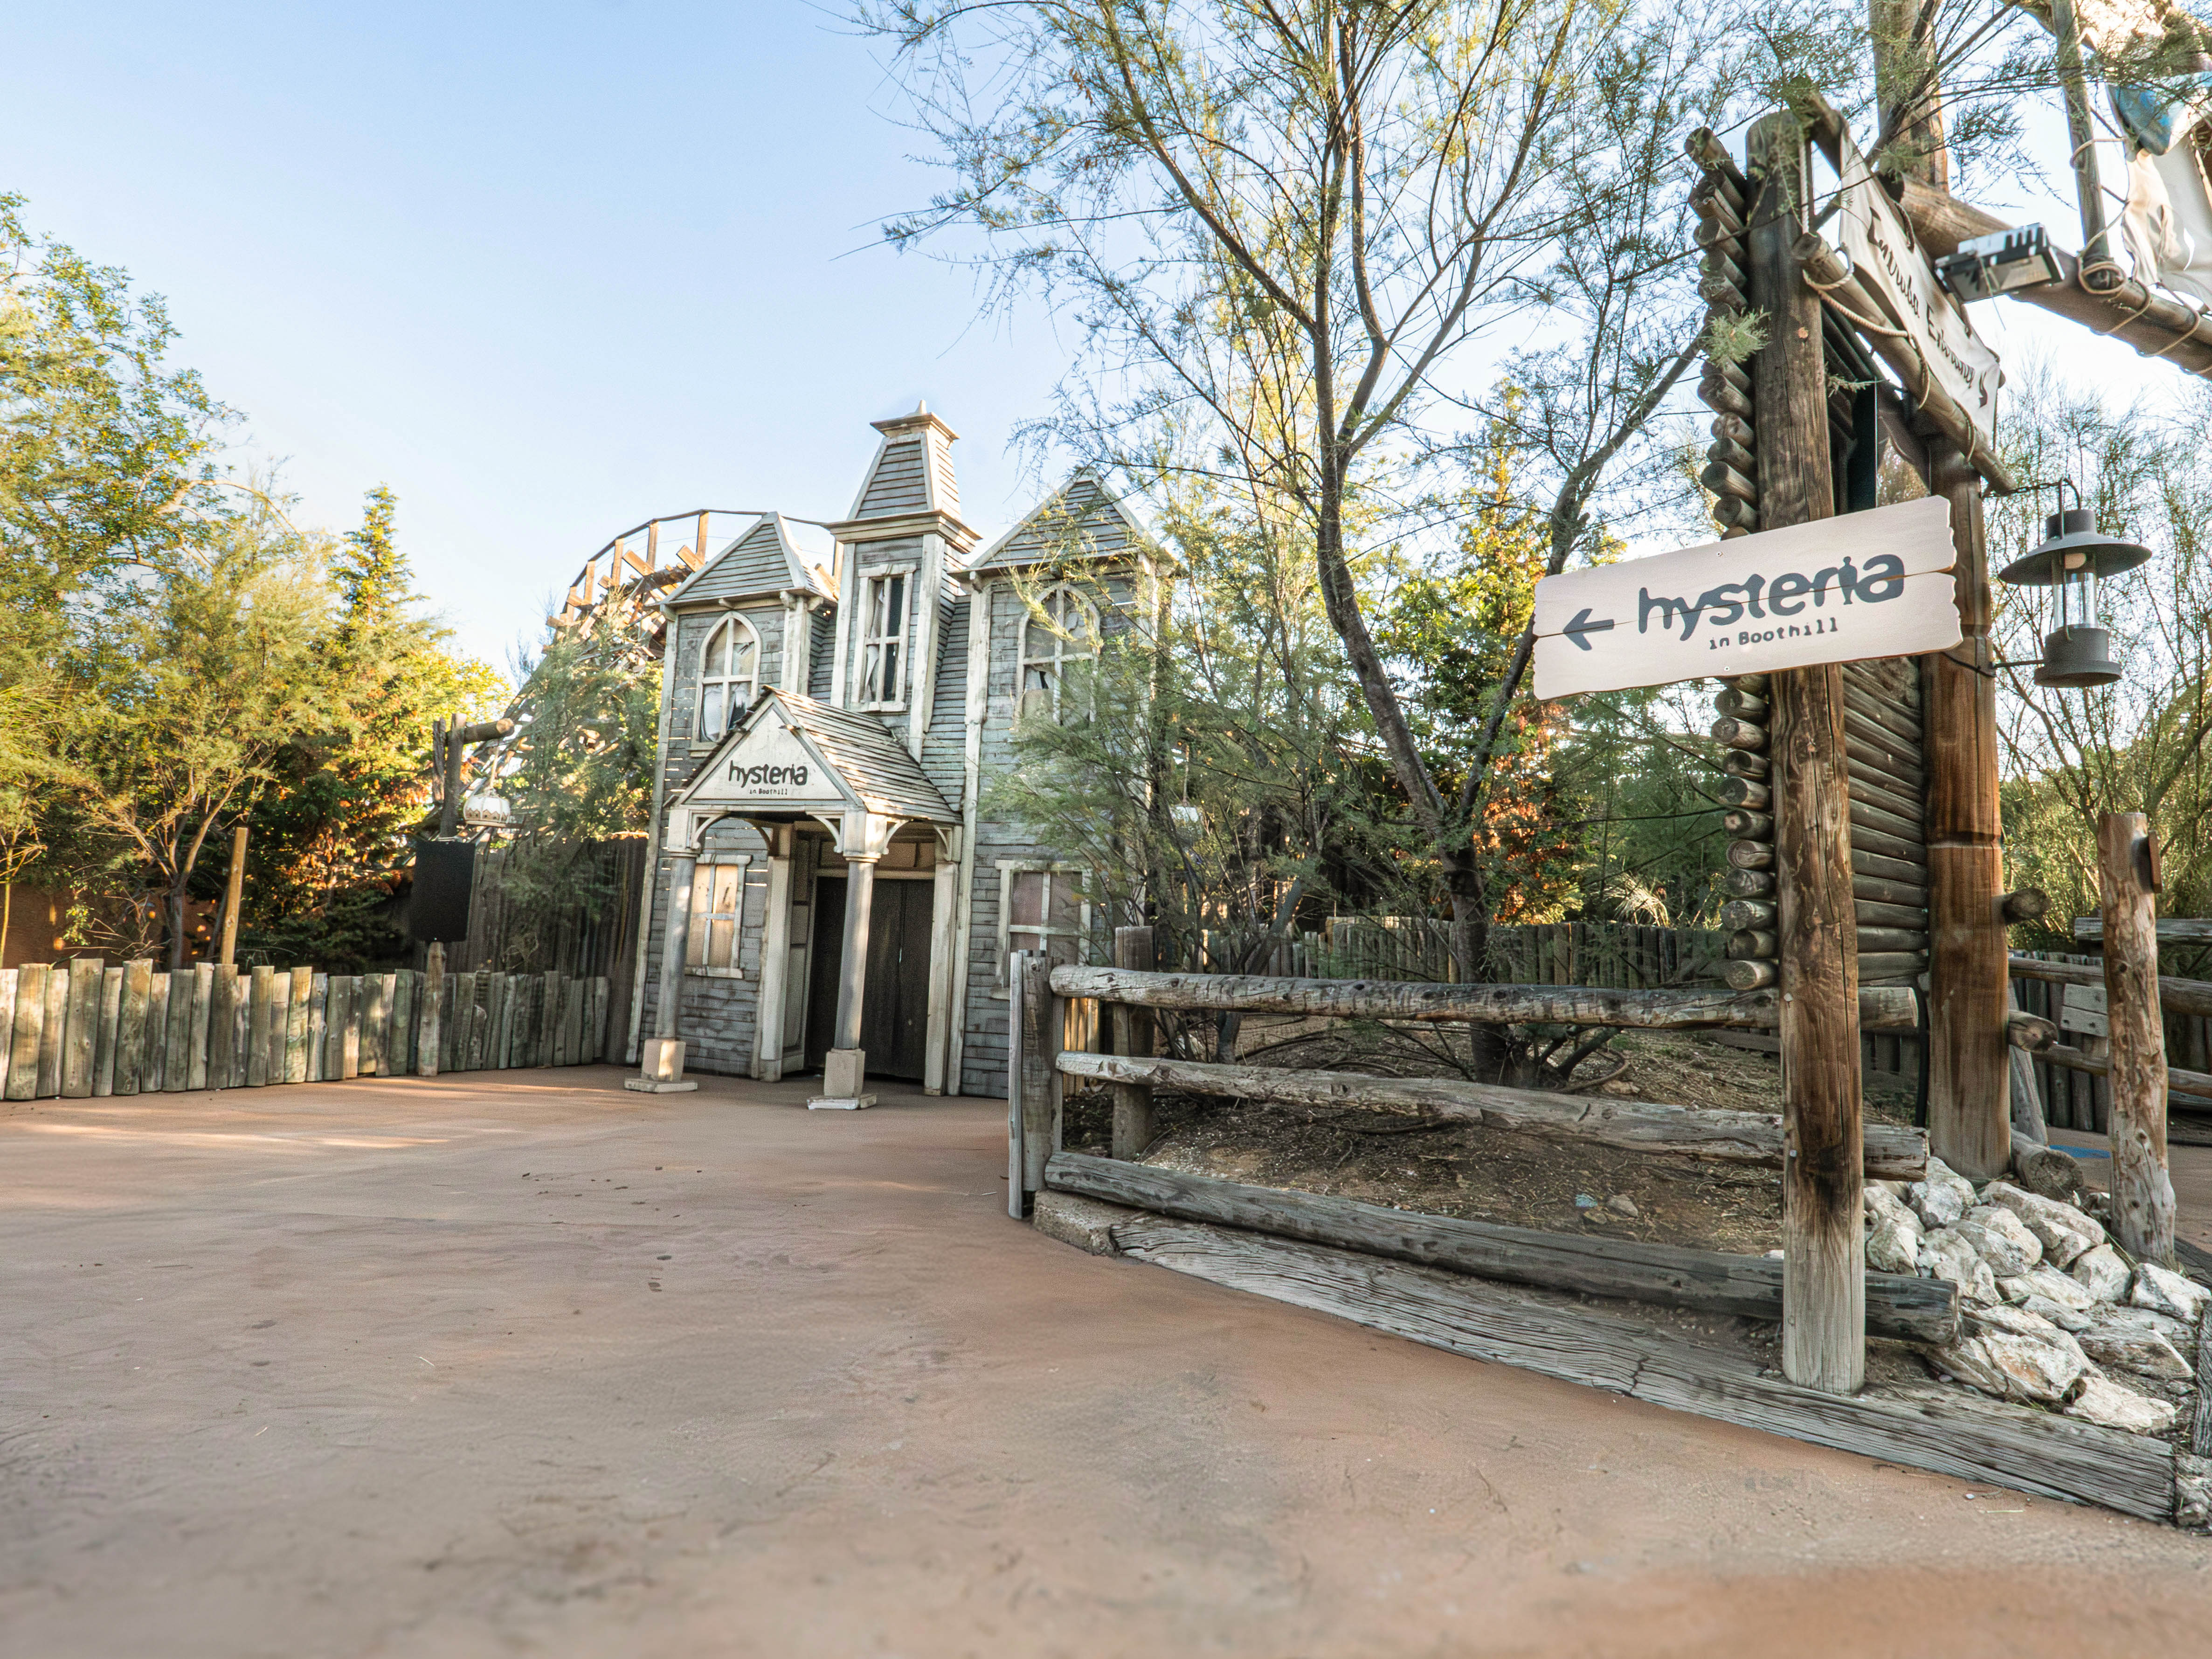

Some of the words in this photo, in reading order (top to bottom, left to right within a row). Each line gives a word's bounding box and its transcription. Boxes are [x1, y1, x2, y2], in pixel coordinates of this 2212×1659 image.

[1638, 553, 1905, 642] hysteria
[1709, 637, 1730, 650] in
[1738, 616, 1838, 646] Boothill
[728, 760, 808, 788] hysteria
